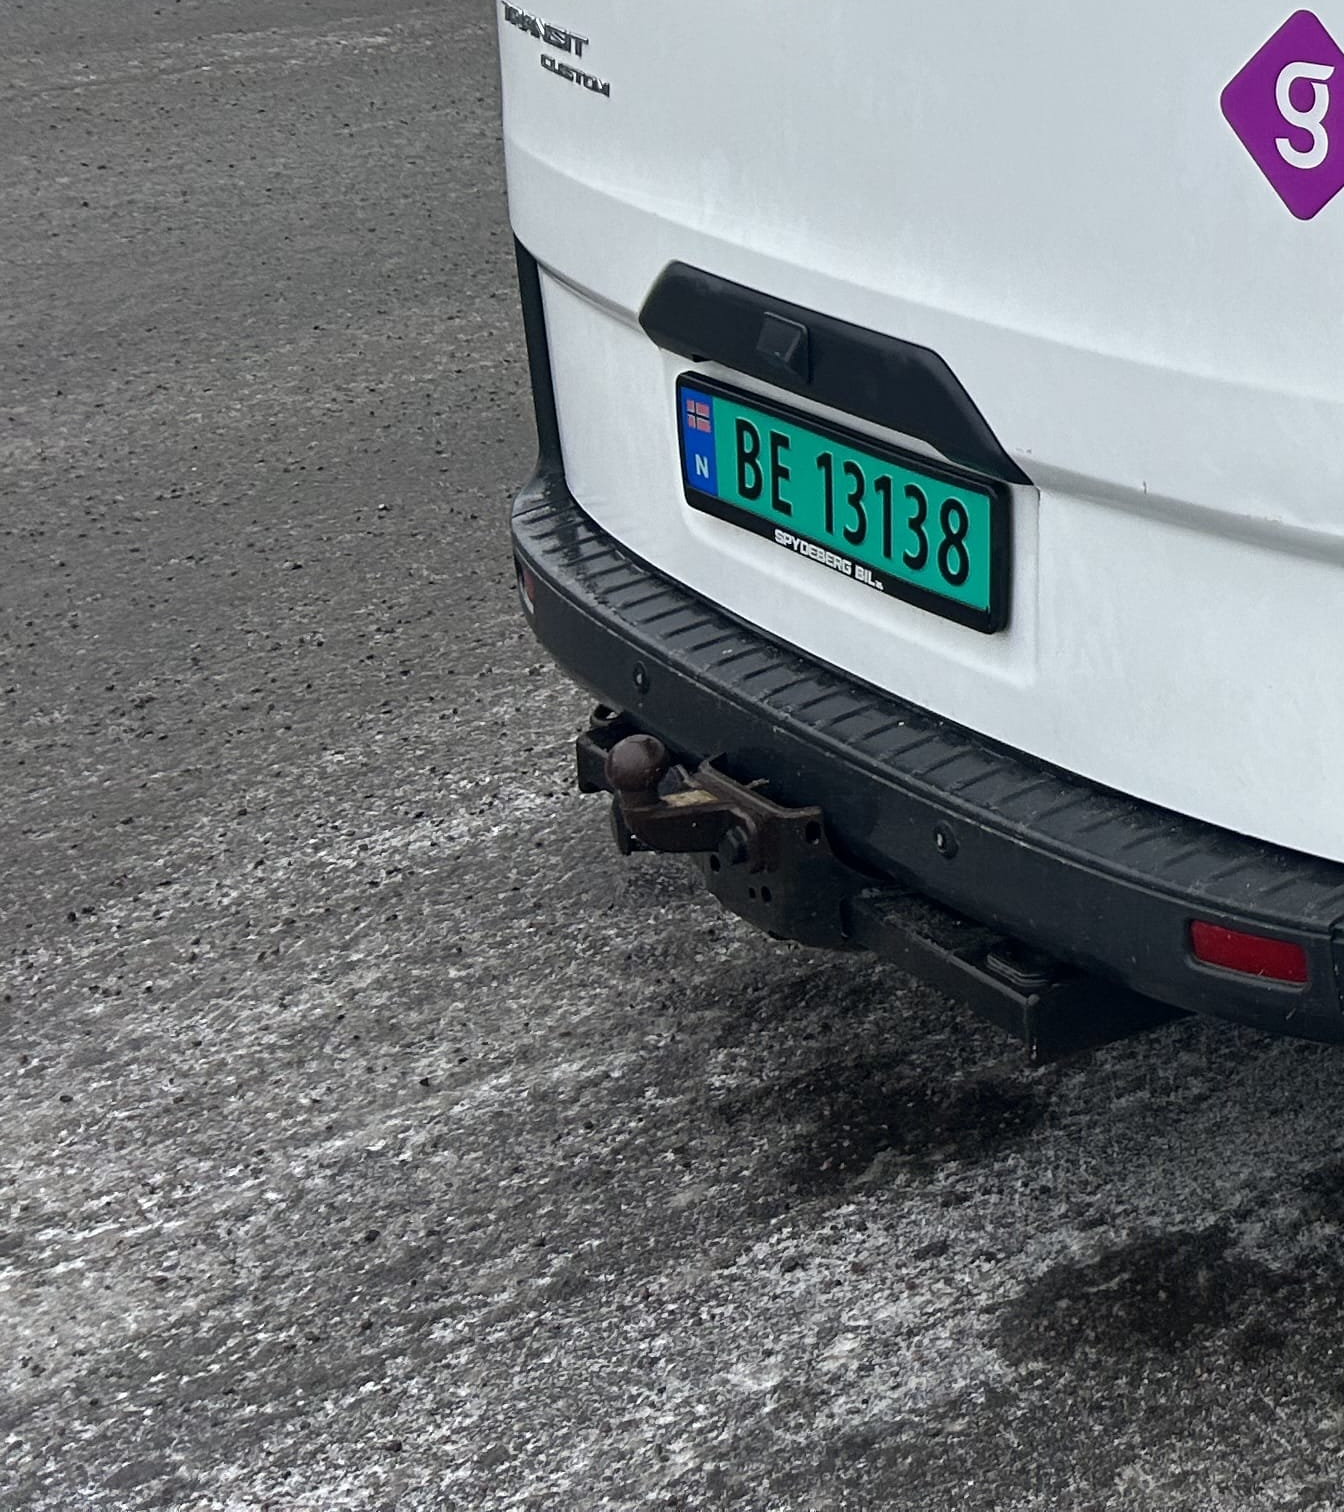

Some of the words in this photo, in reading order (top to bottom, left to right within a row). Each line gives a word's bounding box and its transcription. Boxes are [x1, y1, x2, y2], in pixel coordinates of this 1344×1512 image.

[501, 0, 589, 58] TRANSIT
[540, 53, 611, 98] CUSTOM
[694, 454, 710, 480] N
[734, 416, 793, 517] BE
[815, 451, 970, 587] 13138
[774, 528, 852, 576] SPYDEBERG
